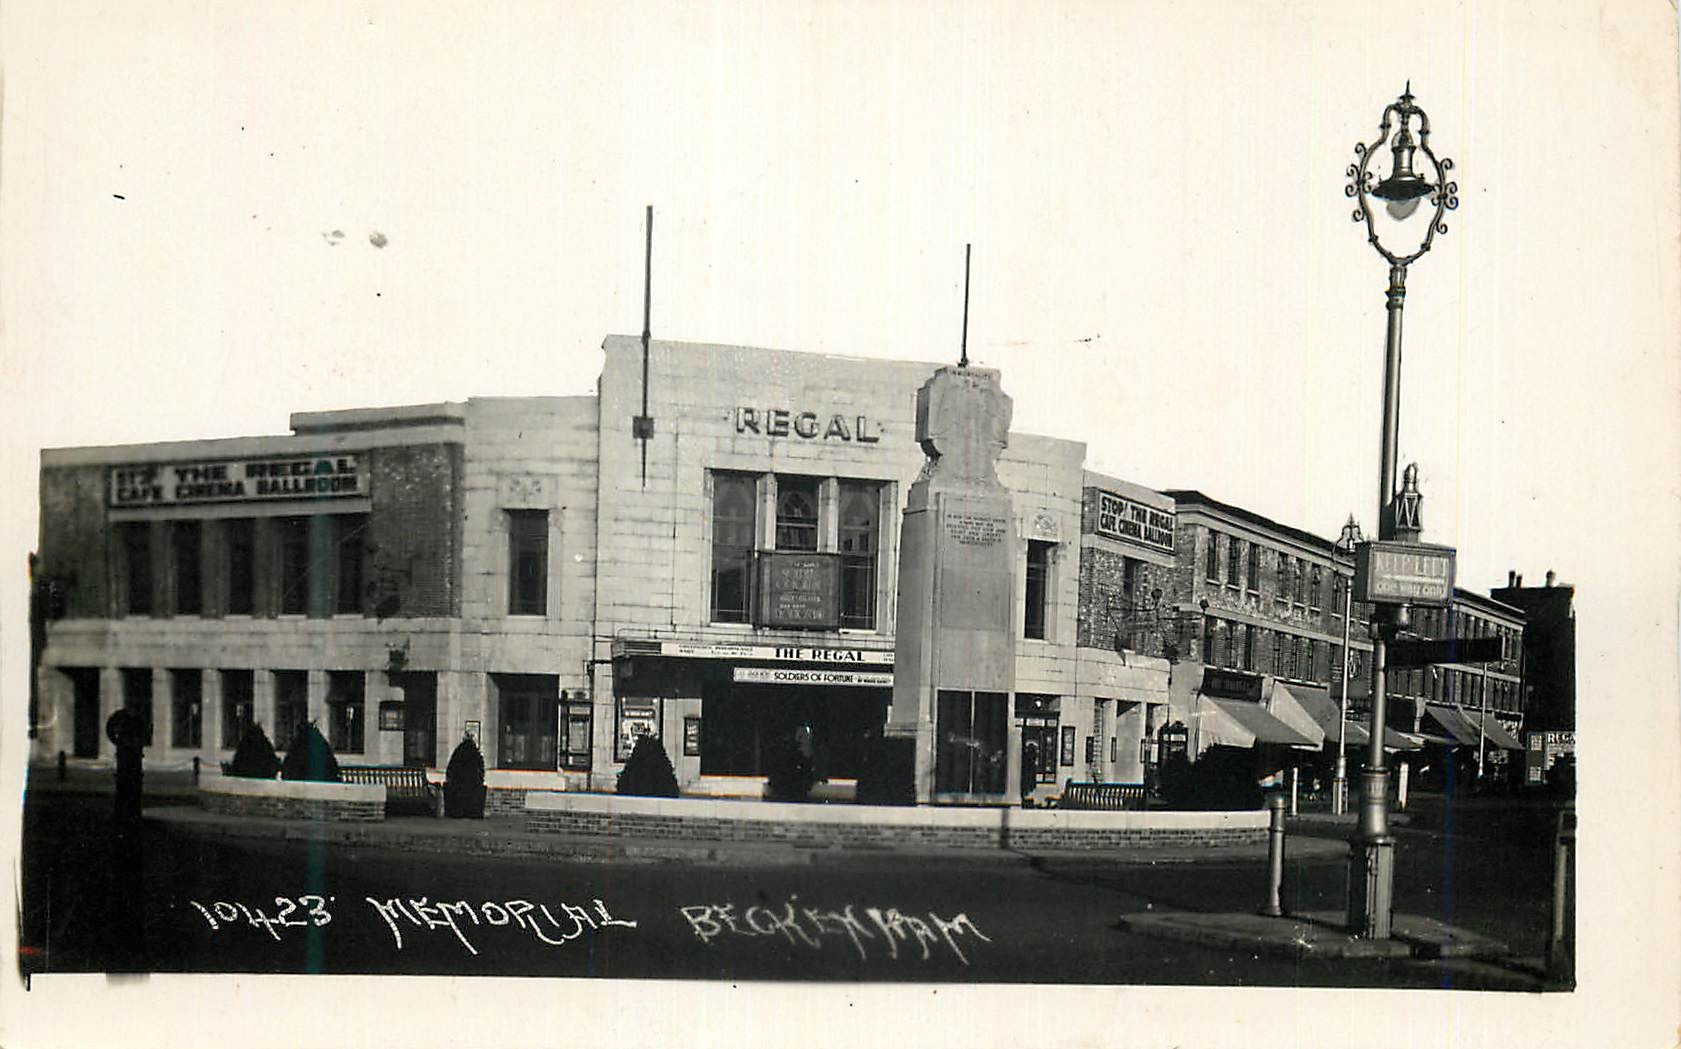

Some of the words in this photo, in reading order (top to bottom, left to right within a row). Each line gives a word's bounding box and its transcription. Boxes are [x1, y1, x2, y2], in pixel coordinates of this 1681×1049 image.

[736, 406, 879, 443] REGAL
[174, 463, 229, 482] THE
[245, 458, 357, 478] REGAL
[1101, 495, 1128, 518] STOP!
[1130, 504, 1148, 525] THE
[1149, 510, 1173, 532] REGAL
[1415, 555, 1449, 577] LEFT
[775, 647, 803, 659] THE
[811, 649, 866, 662] REGAL
[774, 671, 809, 682] SOLDIERS
[810, 672, 823, 682] OF
[823, 672, 854, 684] FORTUNE
